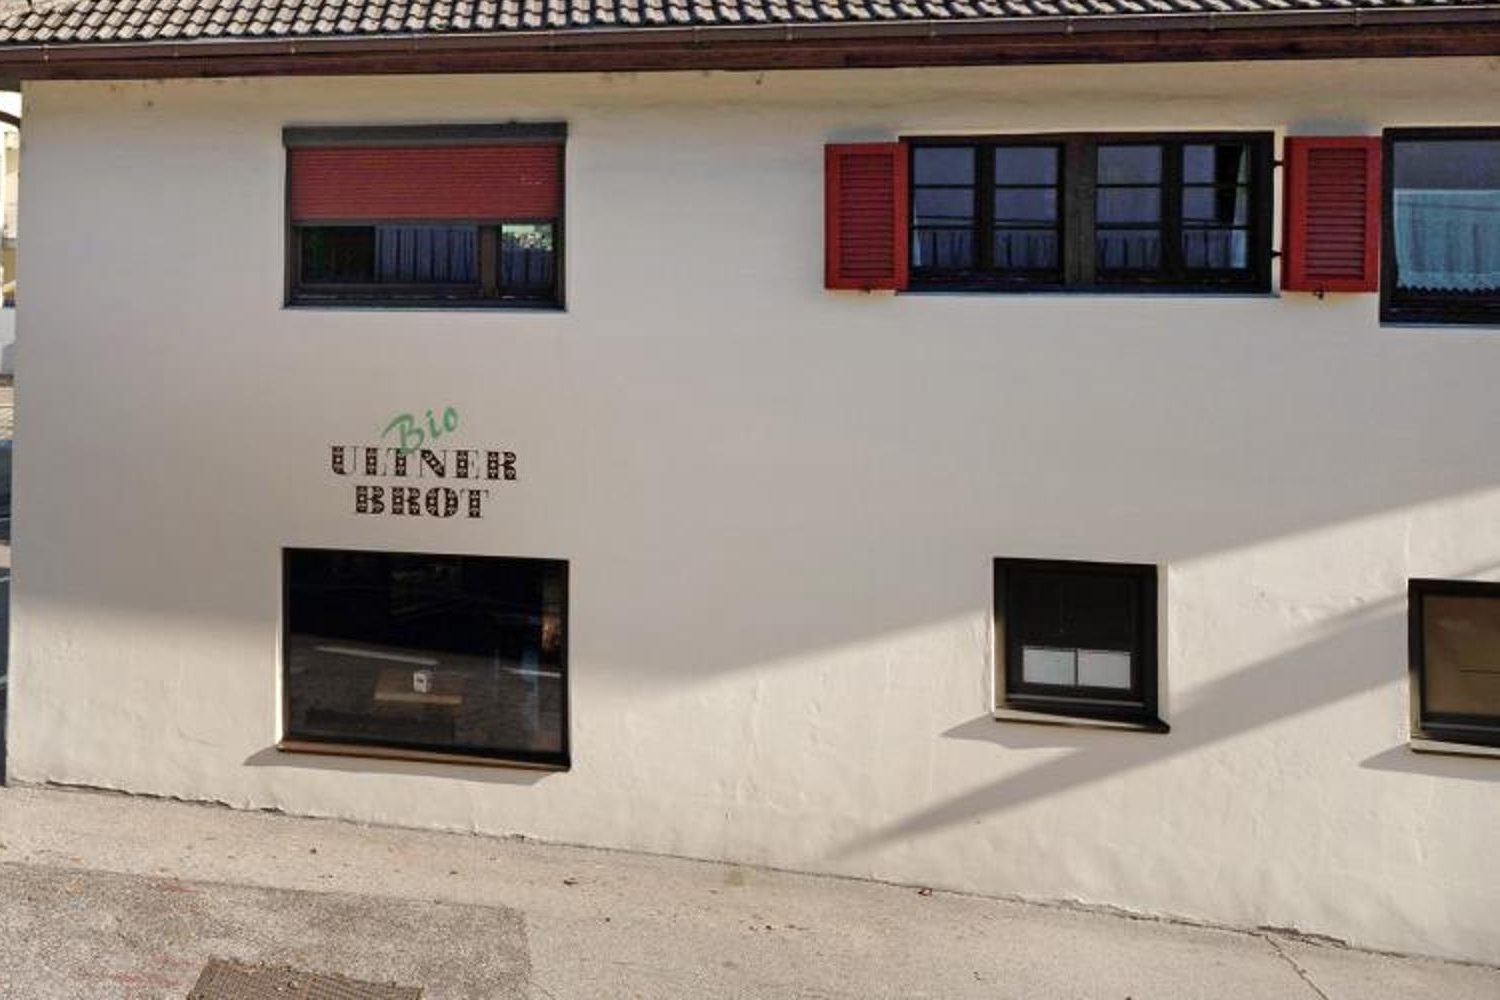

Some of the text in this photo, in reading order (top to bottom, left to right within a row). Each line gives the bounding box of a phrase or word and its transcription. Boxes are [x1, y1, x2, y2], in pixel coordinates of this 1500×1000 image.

[381, 406, 458, 456] Bio
[330, 446, 517, 481] ULTNER
[354, 485, 489, 519] BROT
